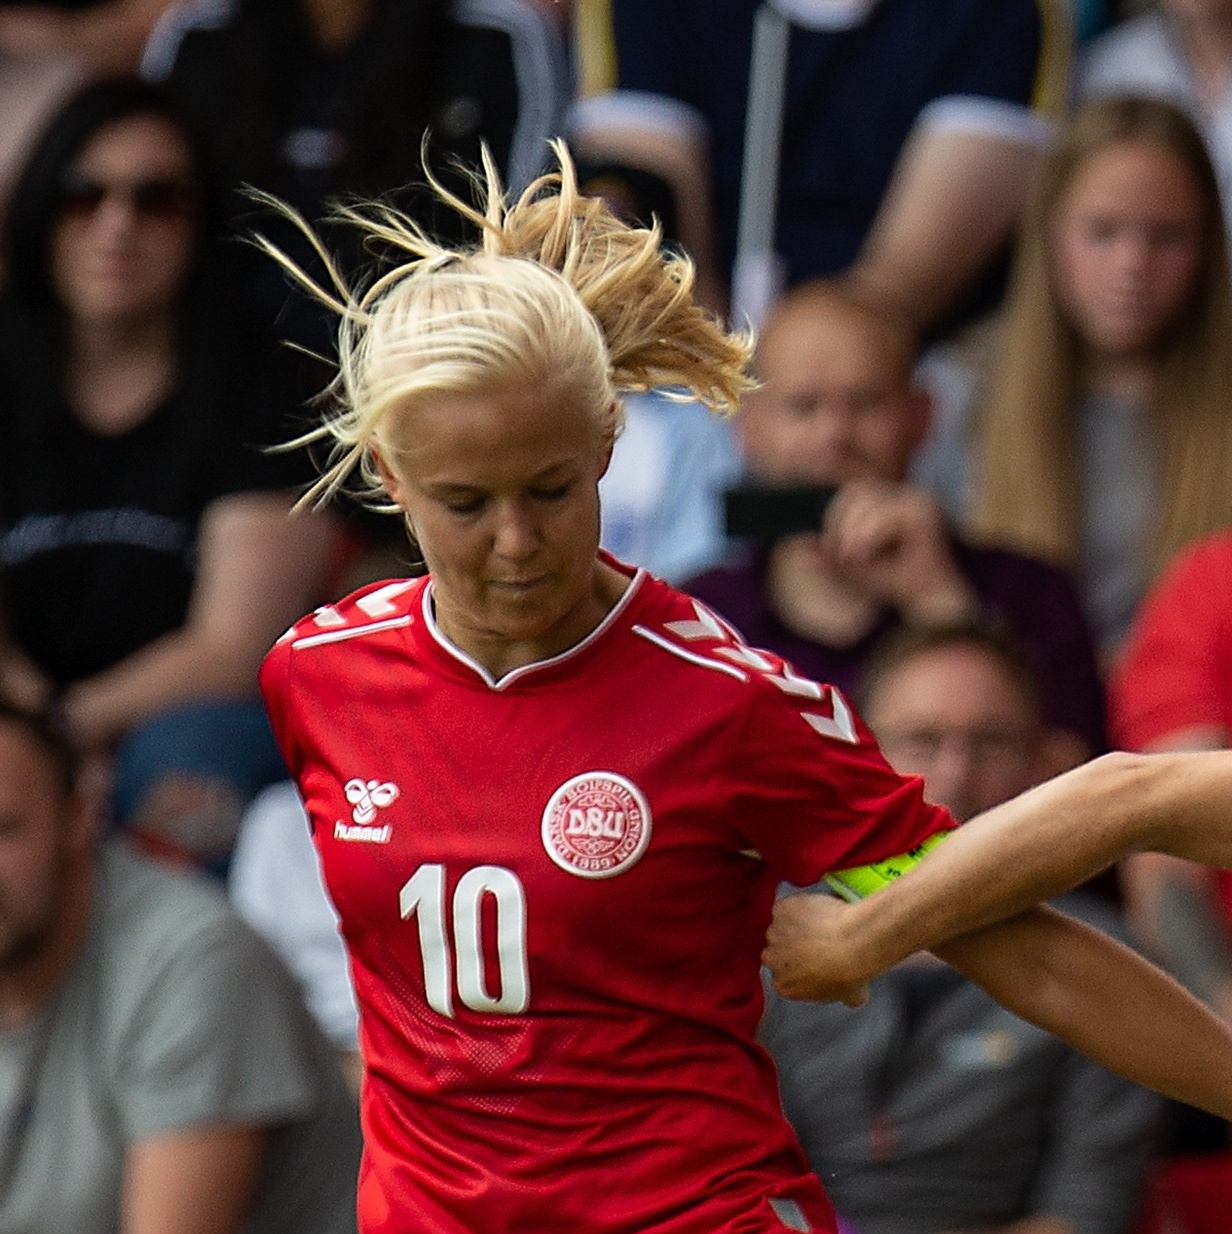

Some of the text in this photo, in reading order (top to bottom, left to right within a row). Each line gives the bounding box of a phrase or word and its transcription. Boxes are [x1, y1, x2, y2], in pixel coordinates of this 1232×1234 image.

[334, 820, 391, 844] hummel
[551, 801, 571, 856] DANSK
[566, 807, 624, 838] DBU
[399, 863, 530, 1019] 10
